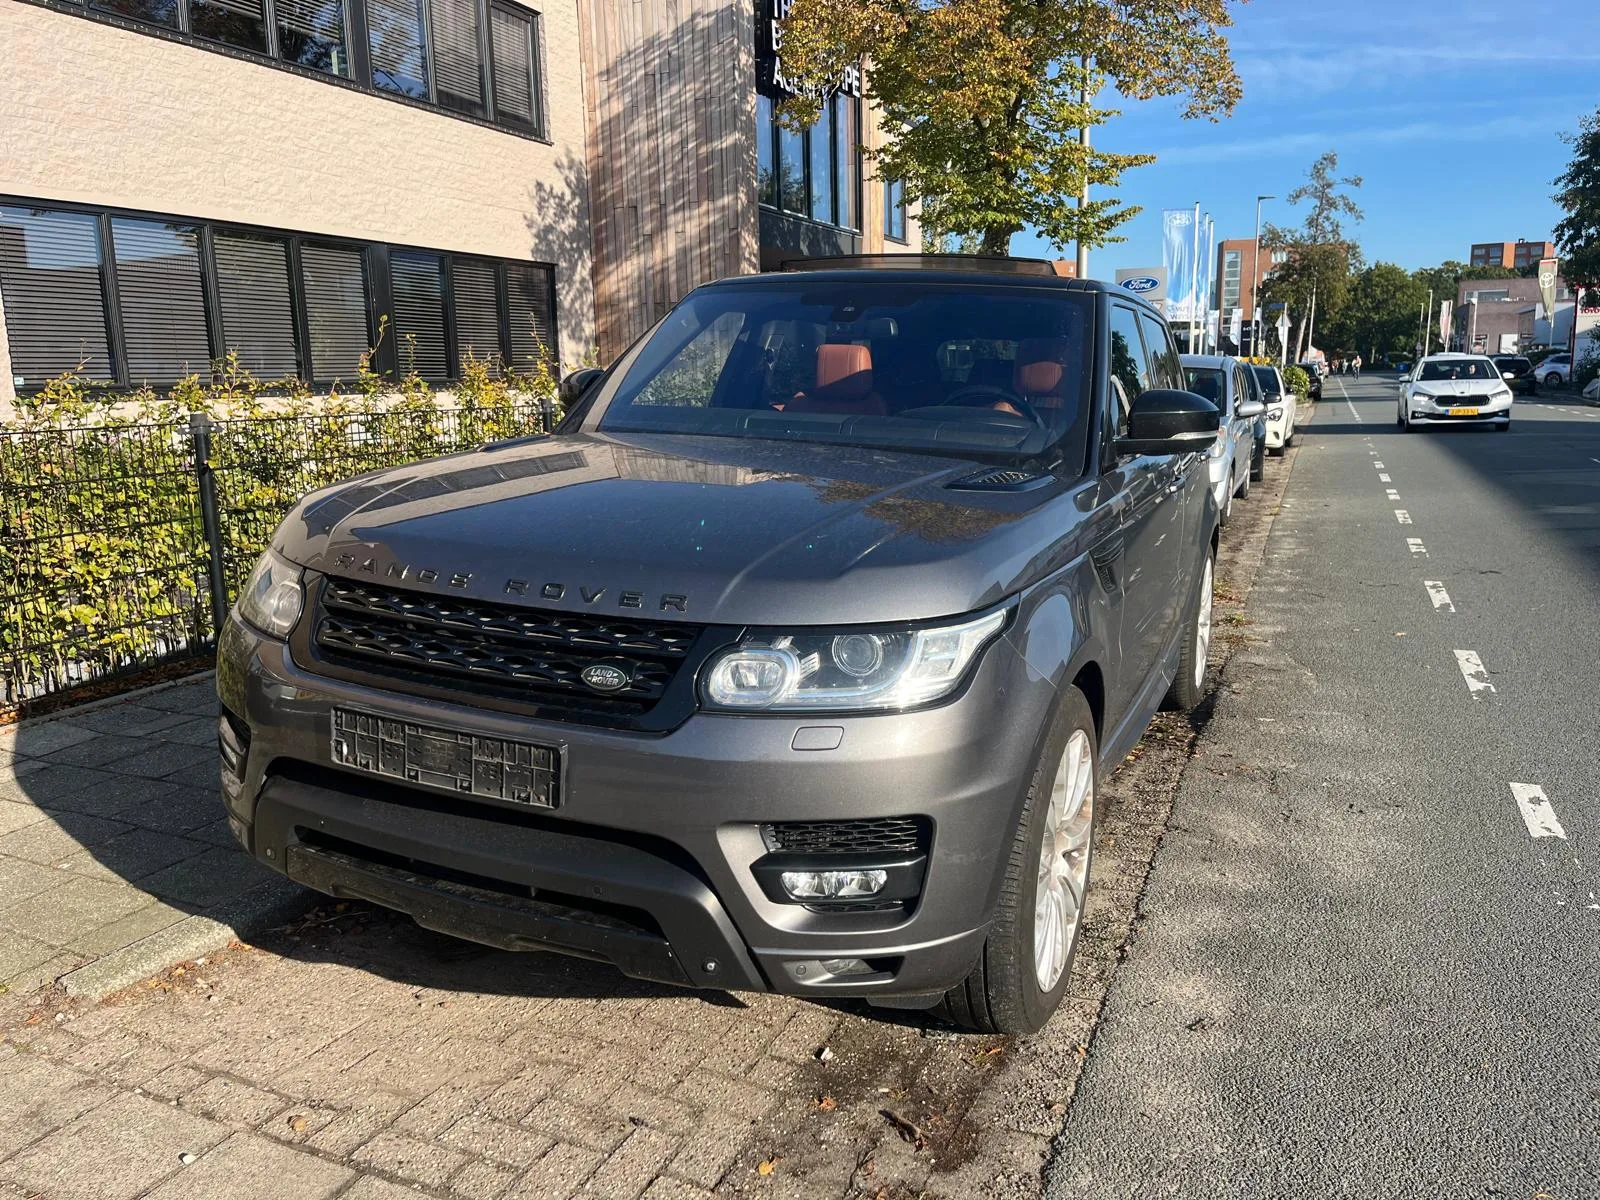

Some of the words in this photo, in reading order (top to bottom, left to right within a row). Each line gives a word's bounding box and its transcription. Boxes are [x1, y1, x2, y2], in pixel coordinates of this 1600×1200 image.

[1128, 279, 1153, 290] Ford
[334, 553, 473, 589] RANGE
[504, 578, 689, 614] ROVER
[590, 668, 613, 678] LAND
[591, 675, 619, 686] ROVER
